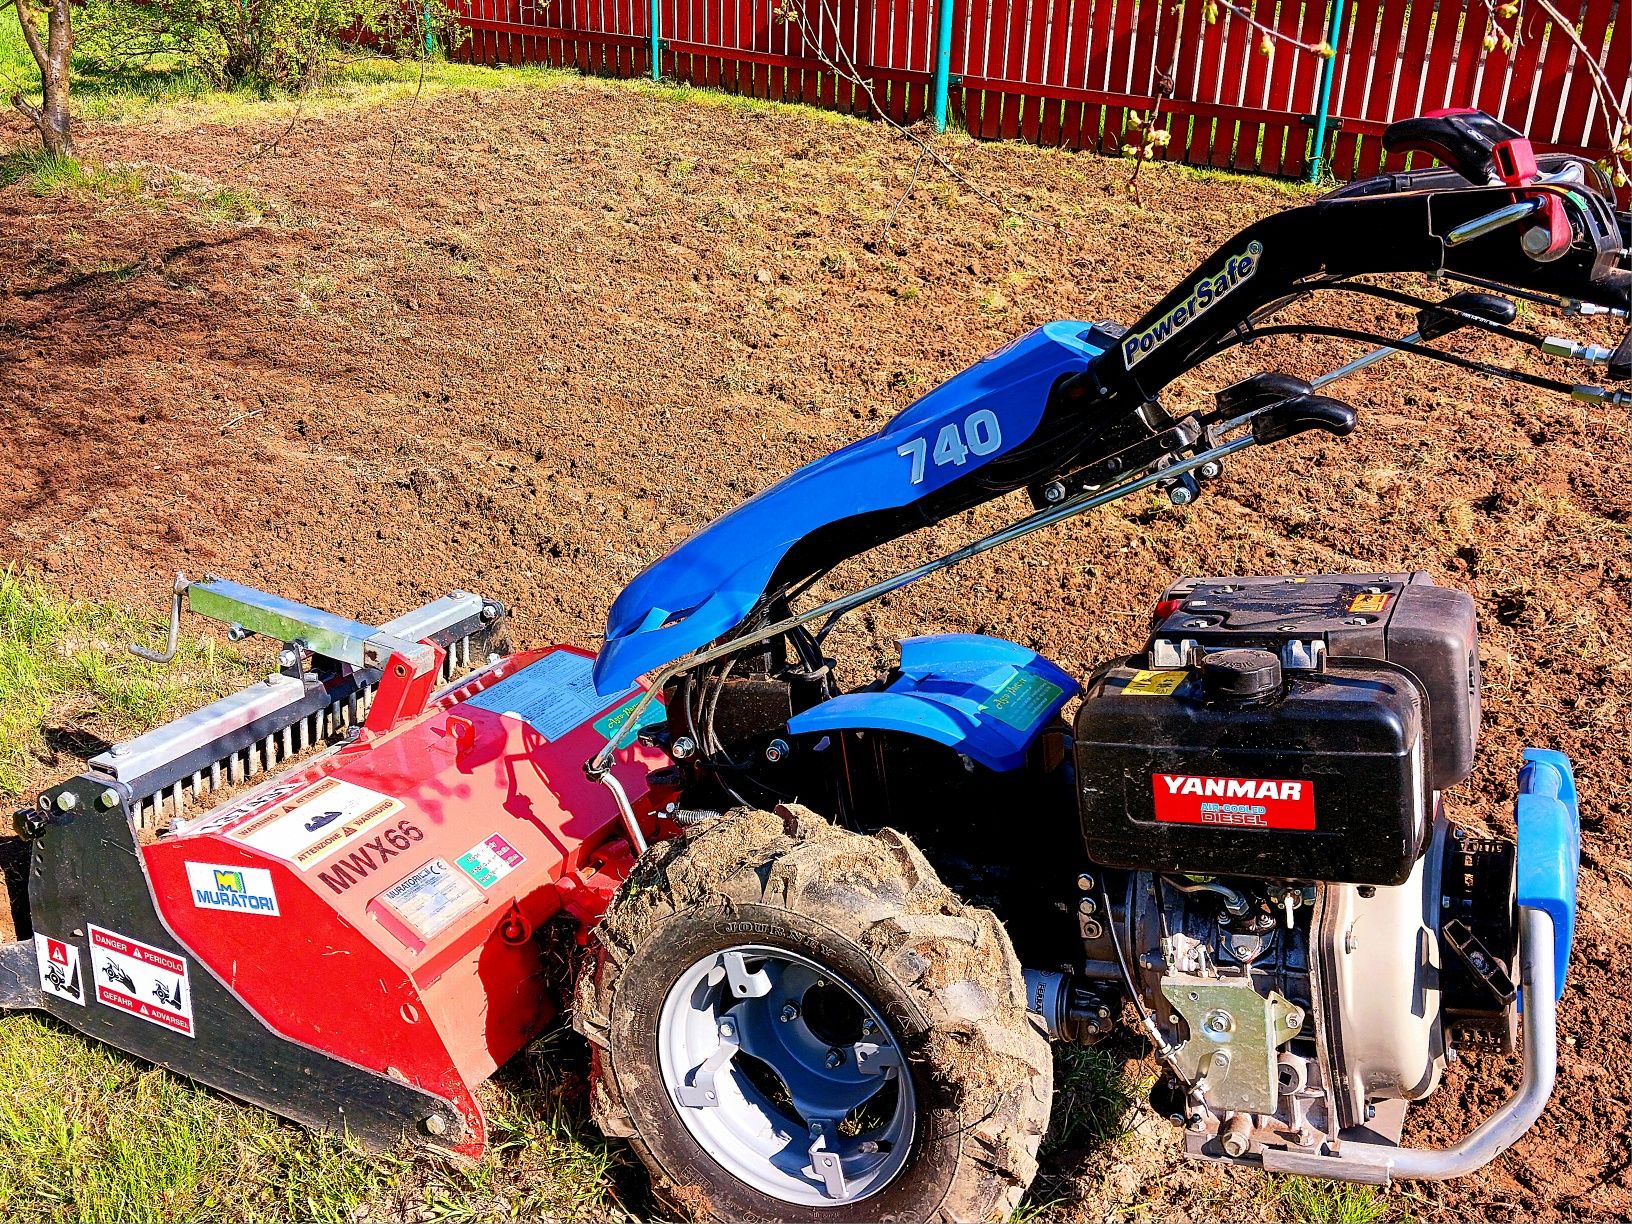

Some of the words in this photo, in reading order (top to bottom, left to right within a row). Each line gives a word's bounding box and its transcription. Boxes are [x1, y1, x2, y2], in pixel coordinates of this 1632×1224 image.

[897, 409, 1002, 485] 740
[1163, 776, 1302, 801] YANMAR
[238, 813, 279, 837] WARNING
[295, 780, 334, 805] ATTENTION
[1201, 812, 1267, 826] DIESEL
[297, 832, 342, 862] ATTENZIONE
[353, 800, 393, 827] WARNUNG
[316, 820, 425, 895] MWX66
[196, 889, 274, 911] MURATORI
[386, 872, 422, 899] MURATORI
[95, 934, 128, 952] DANGER
[144, 951, 183, 972] PERICOLO
[725, 920, 837, 956] JOURNEY
[103, 990, 133, 1007] GEFAHR
[151, 1009, 189, 1029] ADVARSEL
